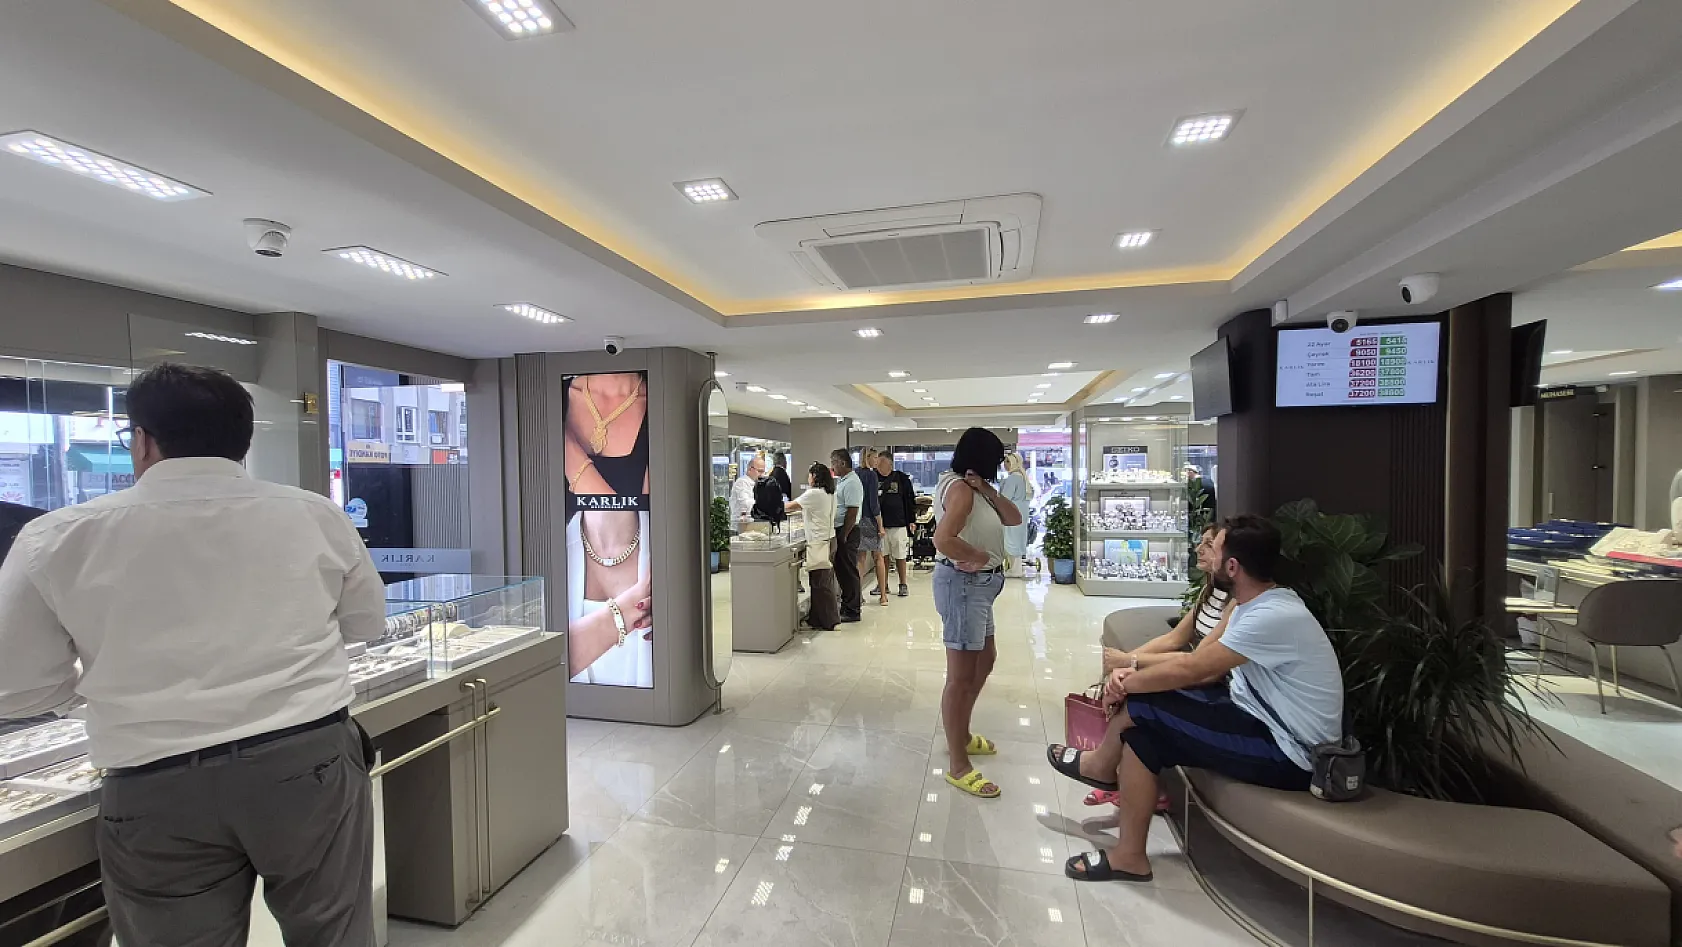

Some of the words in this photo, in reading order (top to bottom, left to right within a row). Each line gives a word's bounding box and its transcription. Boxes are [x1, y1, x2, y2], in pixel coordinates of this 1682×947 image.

[1355, 348, 1376, 356] 9050
[1350, 359, 1376, 367] 18100
[576, 496, 639, 506] KARLIK
